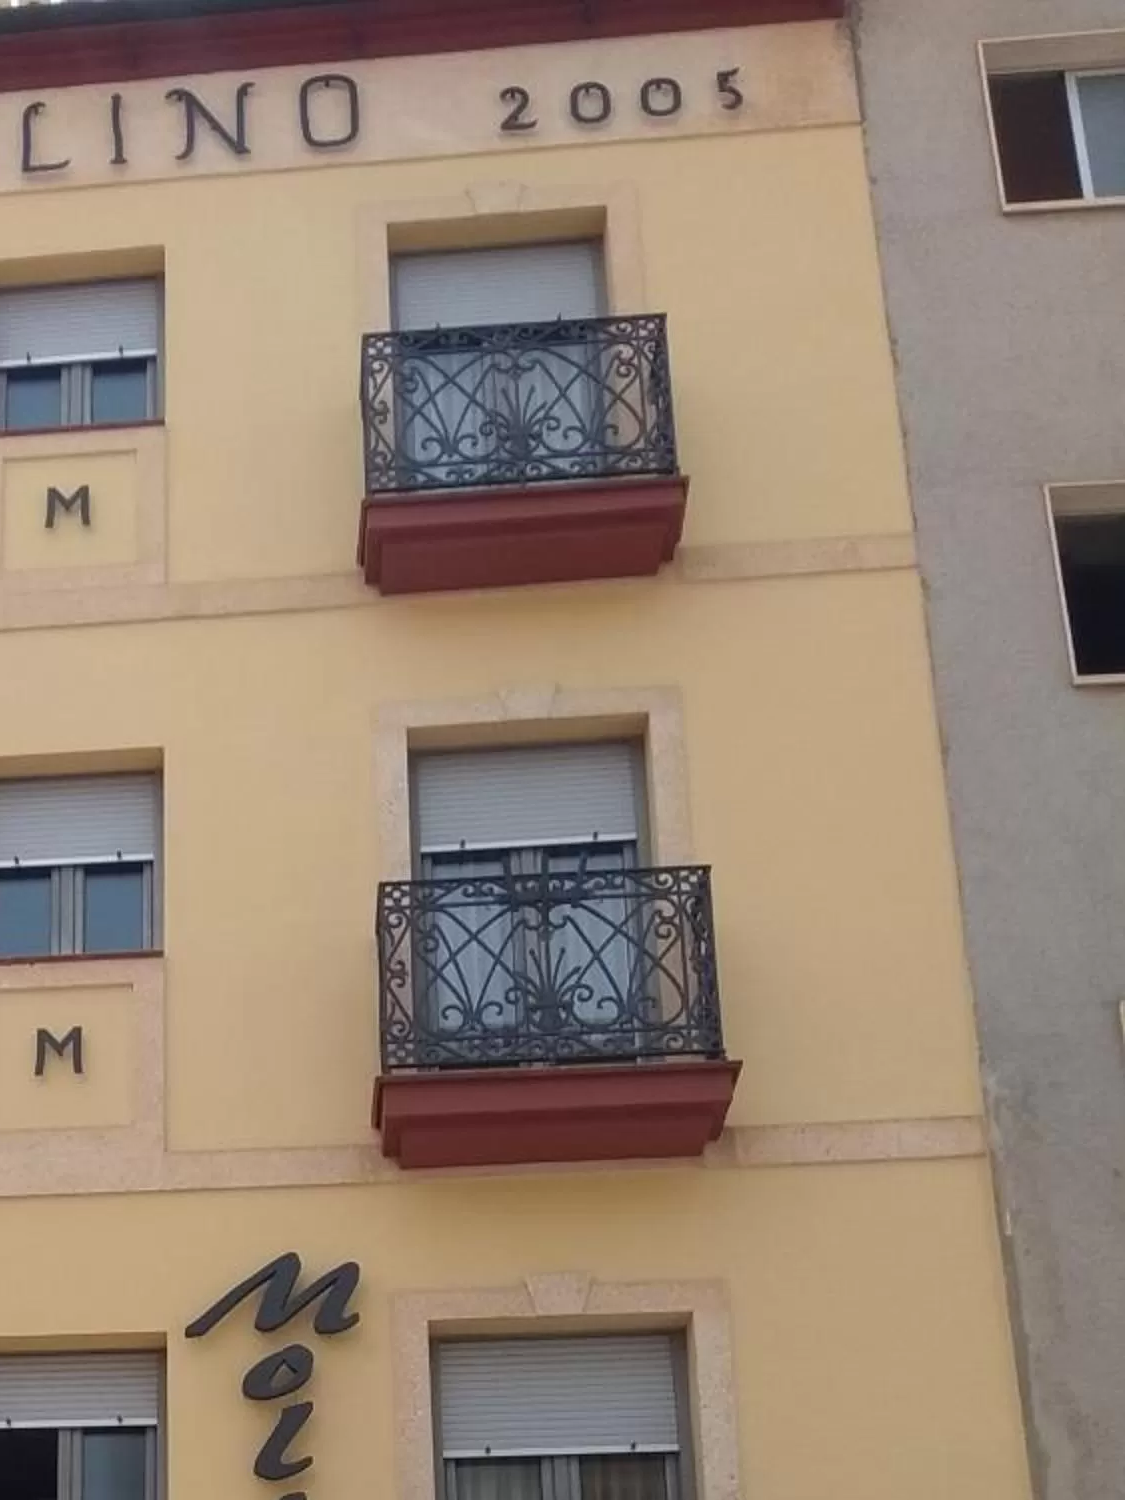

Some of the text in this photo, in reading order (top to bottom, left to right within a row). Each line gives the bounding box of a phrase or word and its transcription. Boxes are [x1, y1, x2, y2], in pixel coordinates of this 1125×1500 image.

[498, 67, 746, 133] 2005
[45, 484, 92, 529] M
[33, 1024, 84, 1077] M
